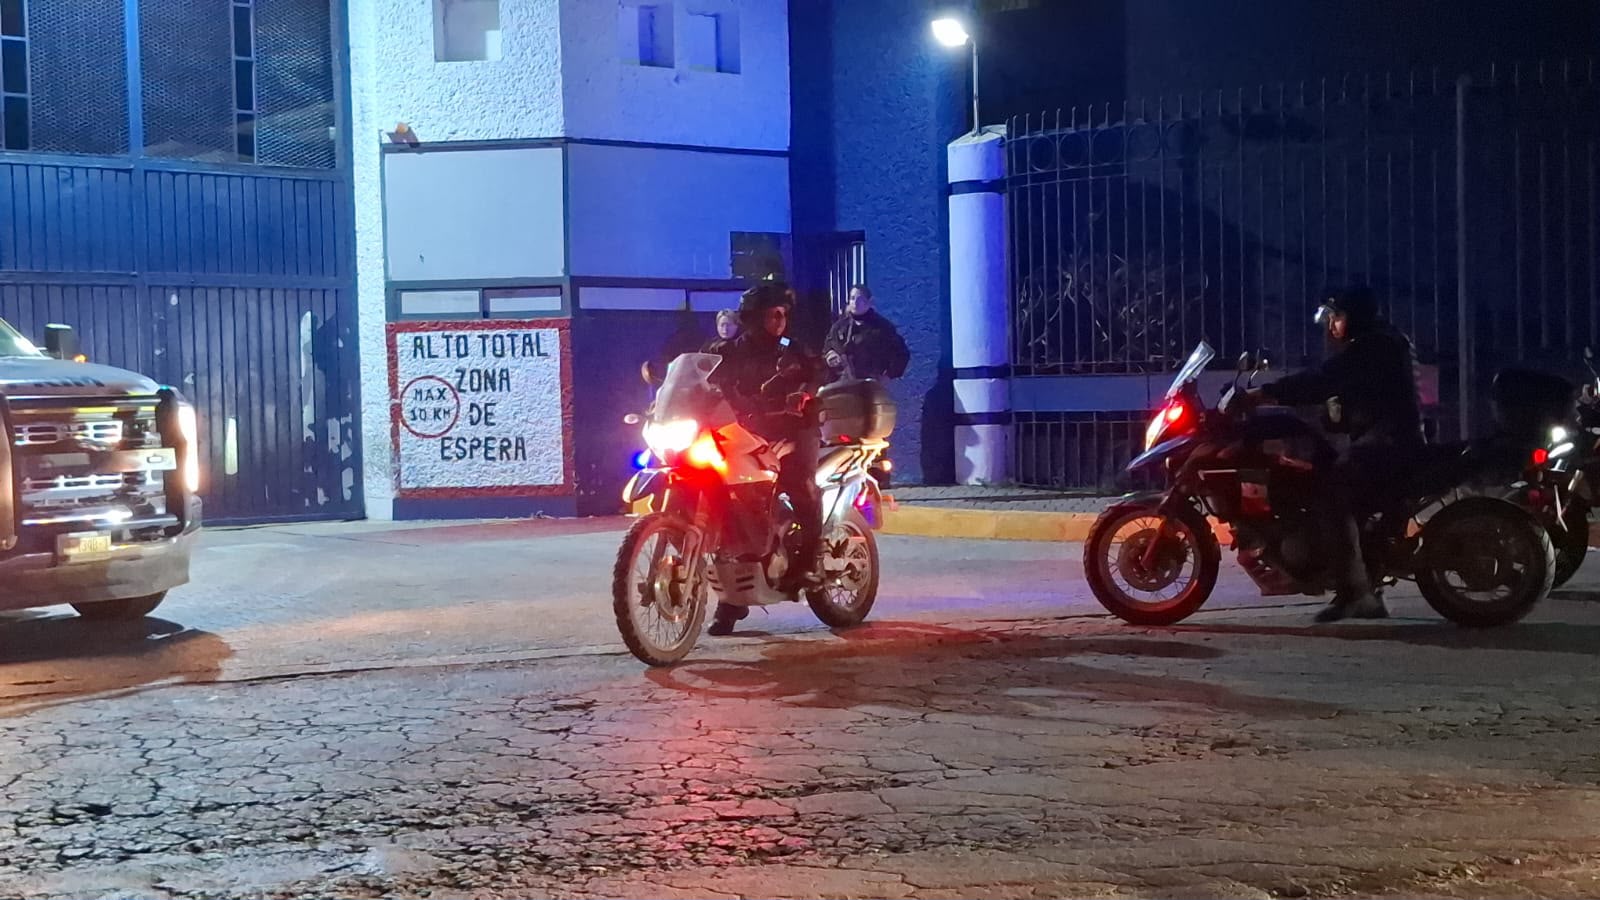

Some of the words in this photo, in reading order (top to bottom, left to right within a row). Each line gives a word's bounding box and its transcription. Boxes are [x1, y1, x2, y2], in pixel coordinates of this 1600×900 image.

[413, 332, 469, 358] ALTO
[478, 332, 549, 358] TOTAL
[455, 368, 510, 393] ZONA
[414, 387, 447, 401] MAX
[410, 407, 427, 421] 10
[469, 402, 497, 426] DE
[441, 436, 527, 461] ESPERA
